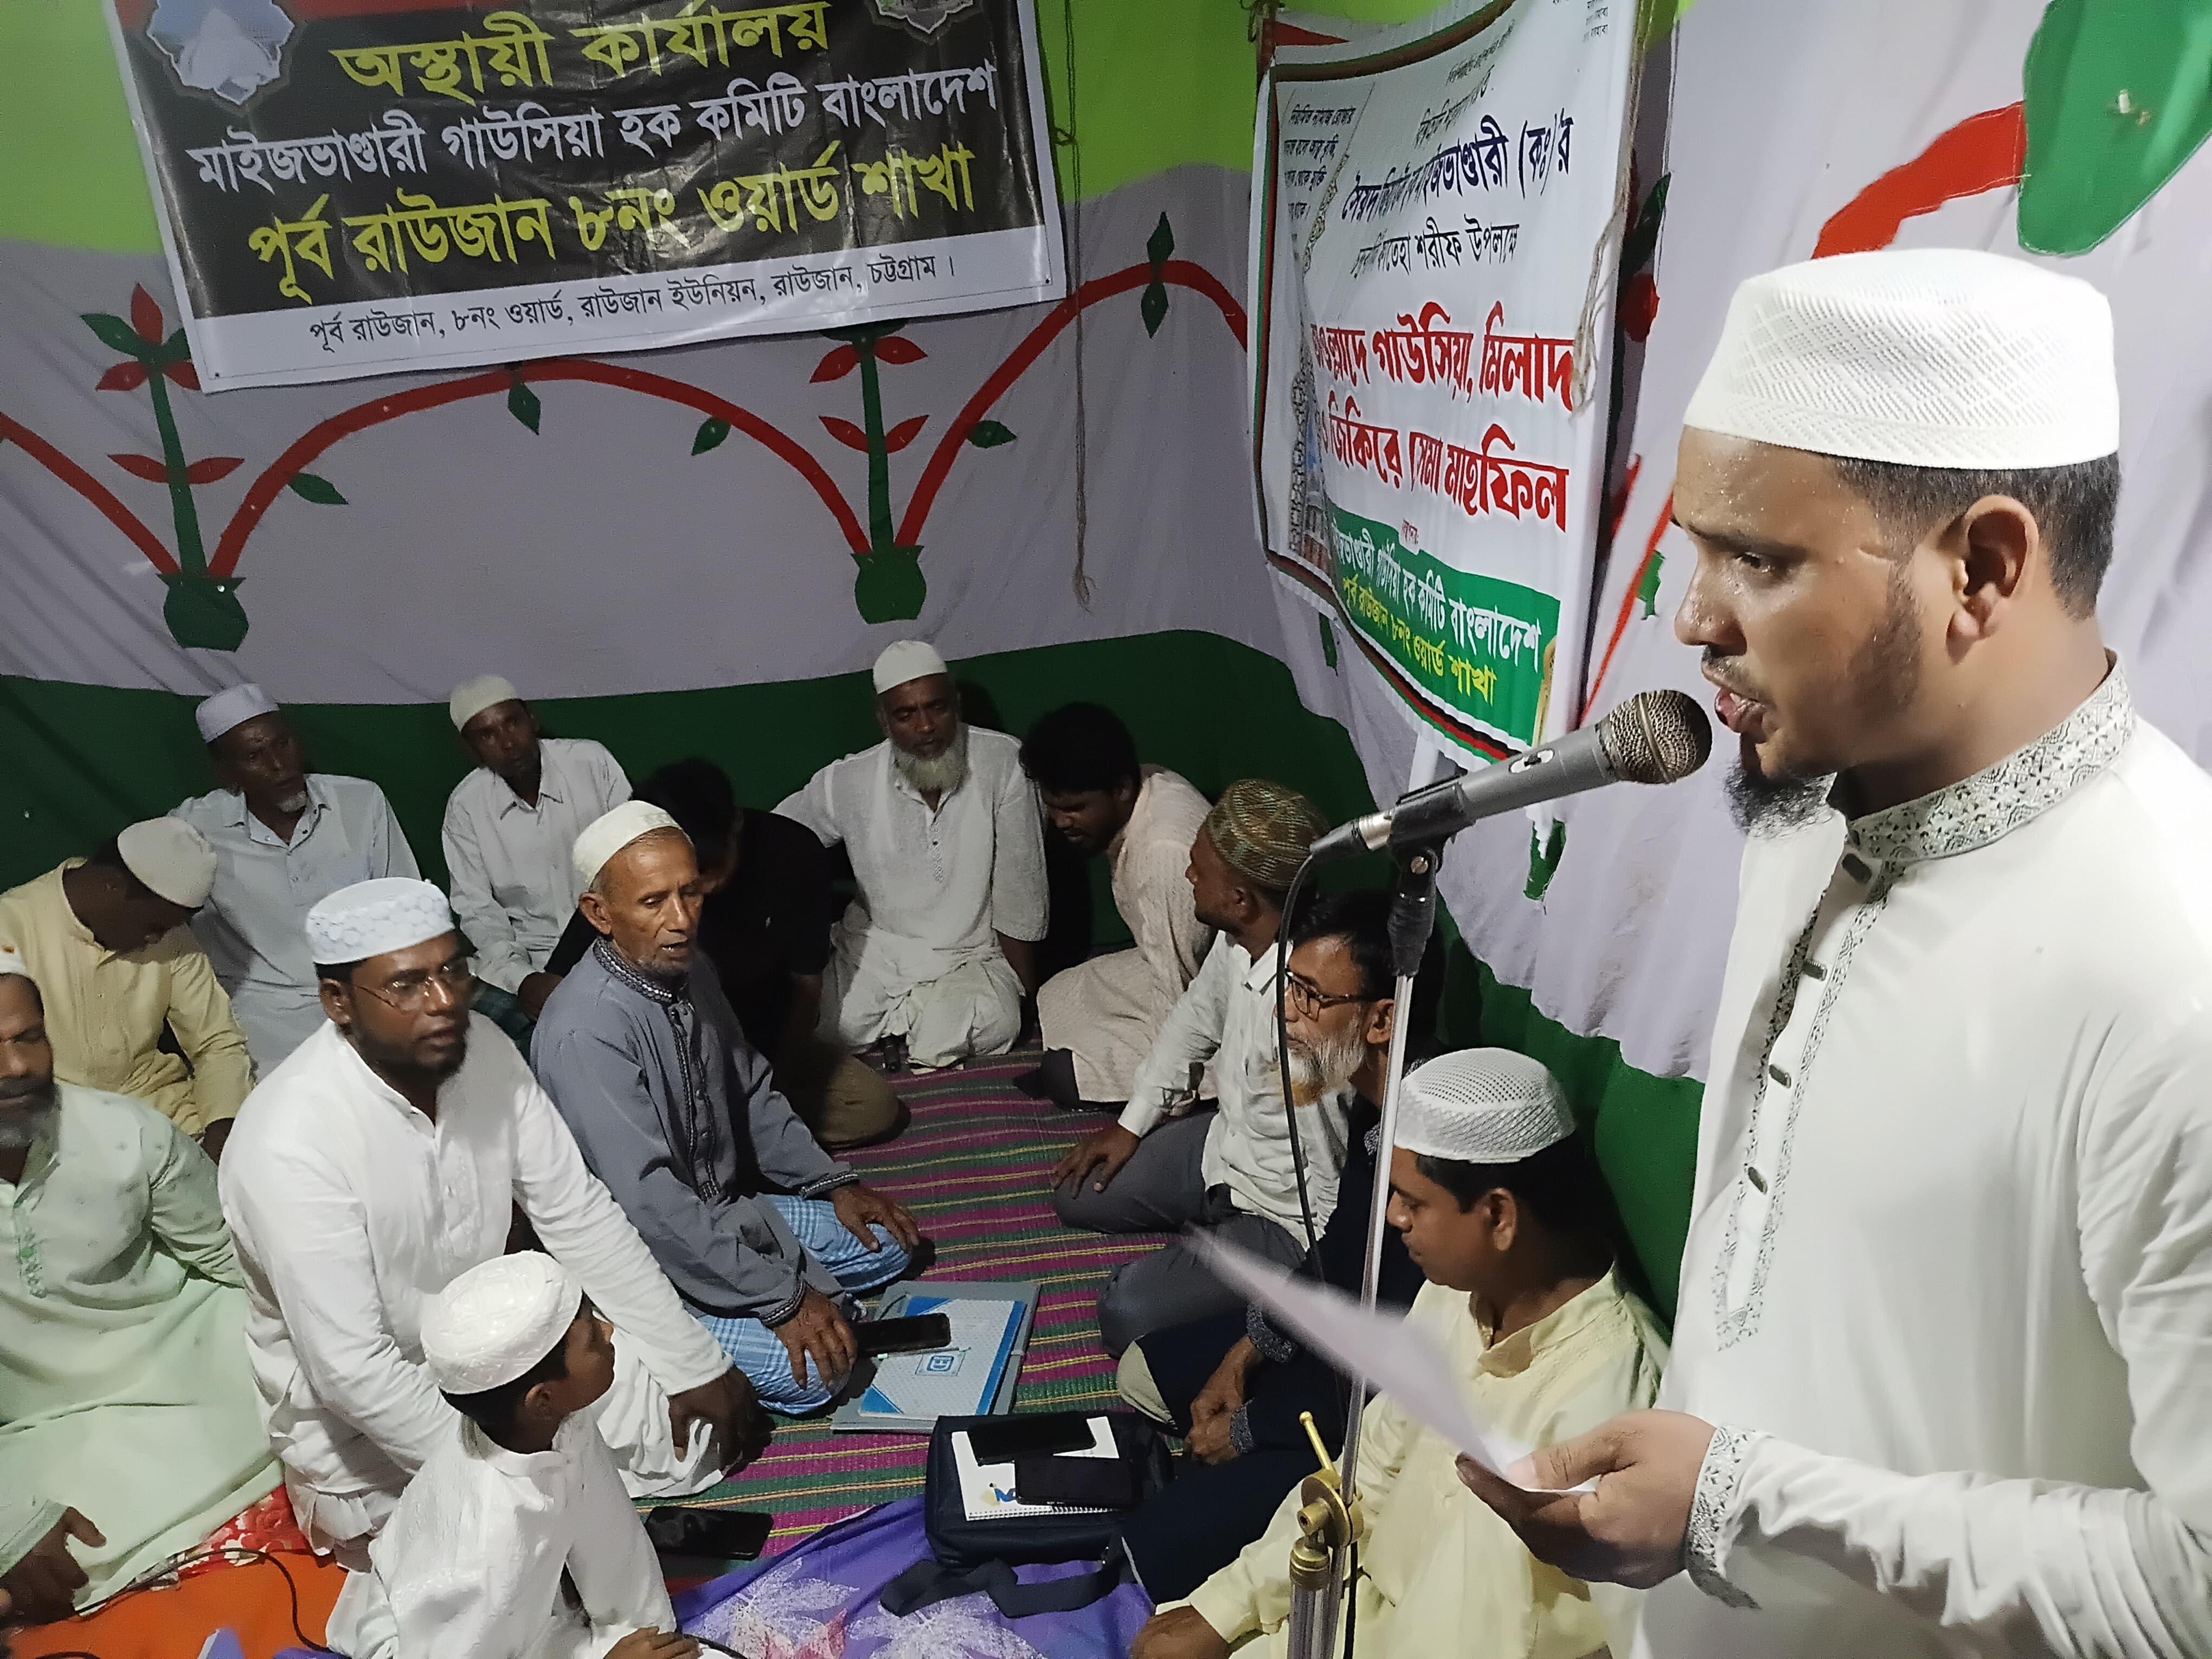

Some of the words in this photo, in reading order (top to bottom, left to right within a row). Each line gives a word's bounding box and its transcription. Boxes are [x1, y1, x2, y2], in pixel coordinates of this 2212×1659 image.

[329, 11, 555, 106] অস্থায়ী
[573, 0, 831, 78] কার্যালয়
[187, 110, 427, 194] মাইজভাণ্ডারী
[442, 102, 605, 170] গাউসিয়া
[614, 103, 682, 158] হক
[689, 71, 808, 142] কমিটি
[815, 57, 997, 128] বাংলাদেশ
[248, 193, 335, 305] পূর্ব
[343, 187, 556, 274] রাউজান
[568, 186, 691, 251] ৮নং
[697, 140, 841, 234] ওয়ার্ড
[851, 140, 976, 220] শাখা
[1414, 216, 1462, 270] শরীফ
[310, 311, 344, 353] পূর্ব
[349, 308, 445, 342] রাউজান,
[452, 305, 500, 330] ৮নং
[504, 289, 573, 326] ওয়ার্ড,
[577, 286, 661, 318] রাউজান
[668, 273, 766, 312] ইউনিয়ন,
[771, 265, 862, 298] রাউজান,
[867, 254, 936, 285] চট্টগ্রাম
[1444, 423, 1570, 532] মাহফিল
[1403, 569, 1416, 618] হক
[1418, 569, 1446, 633] কমিটি
[1448, 597, 1541, 673] বাংলাদেশ
[1413, 639, 1446, 677] ওয়ার্ড
[1448, 654, 1496, 706] শাখা
